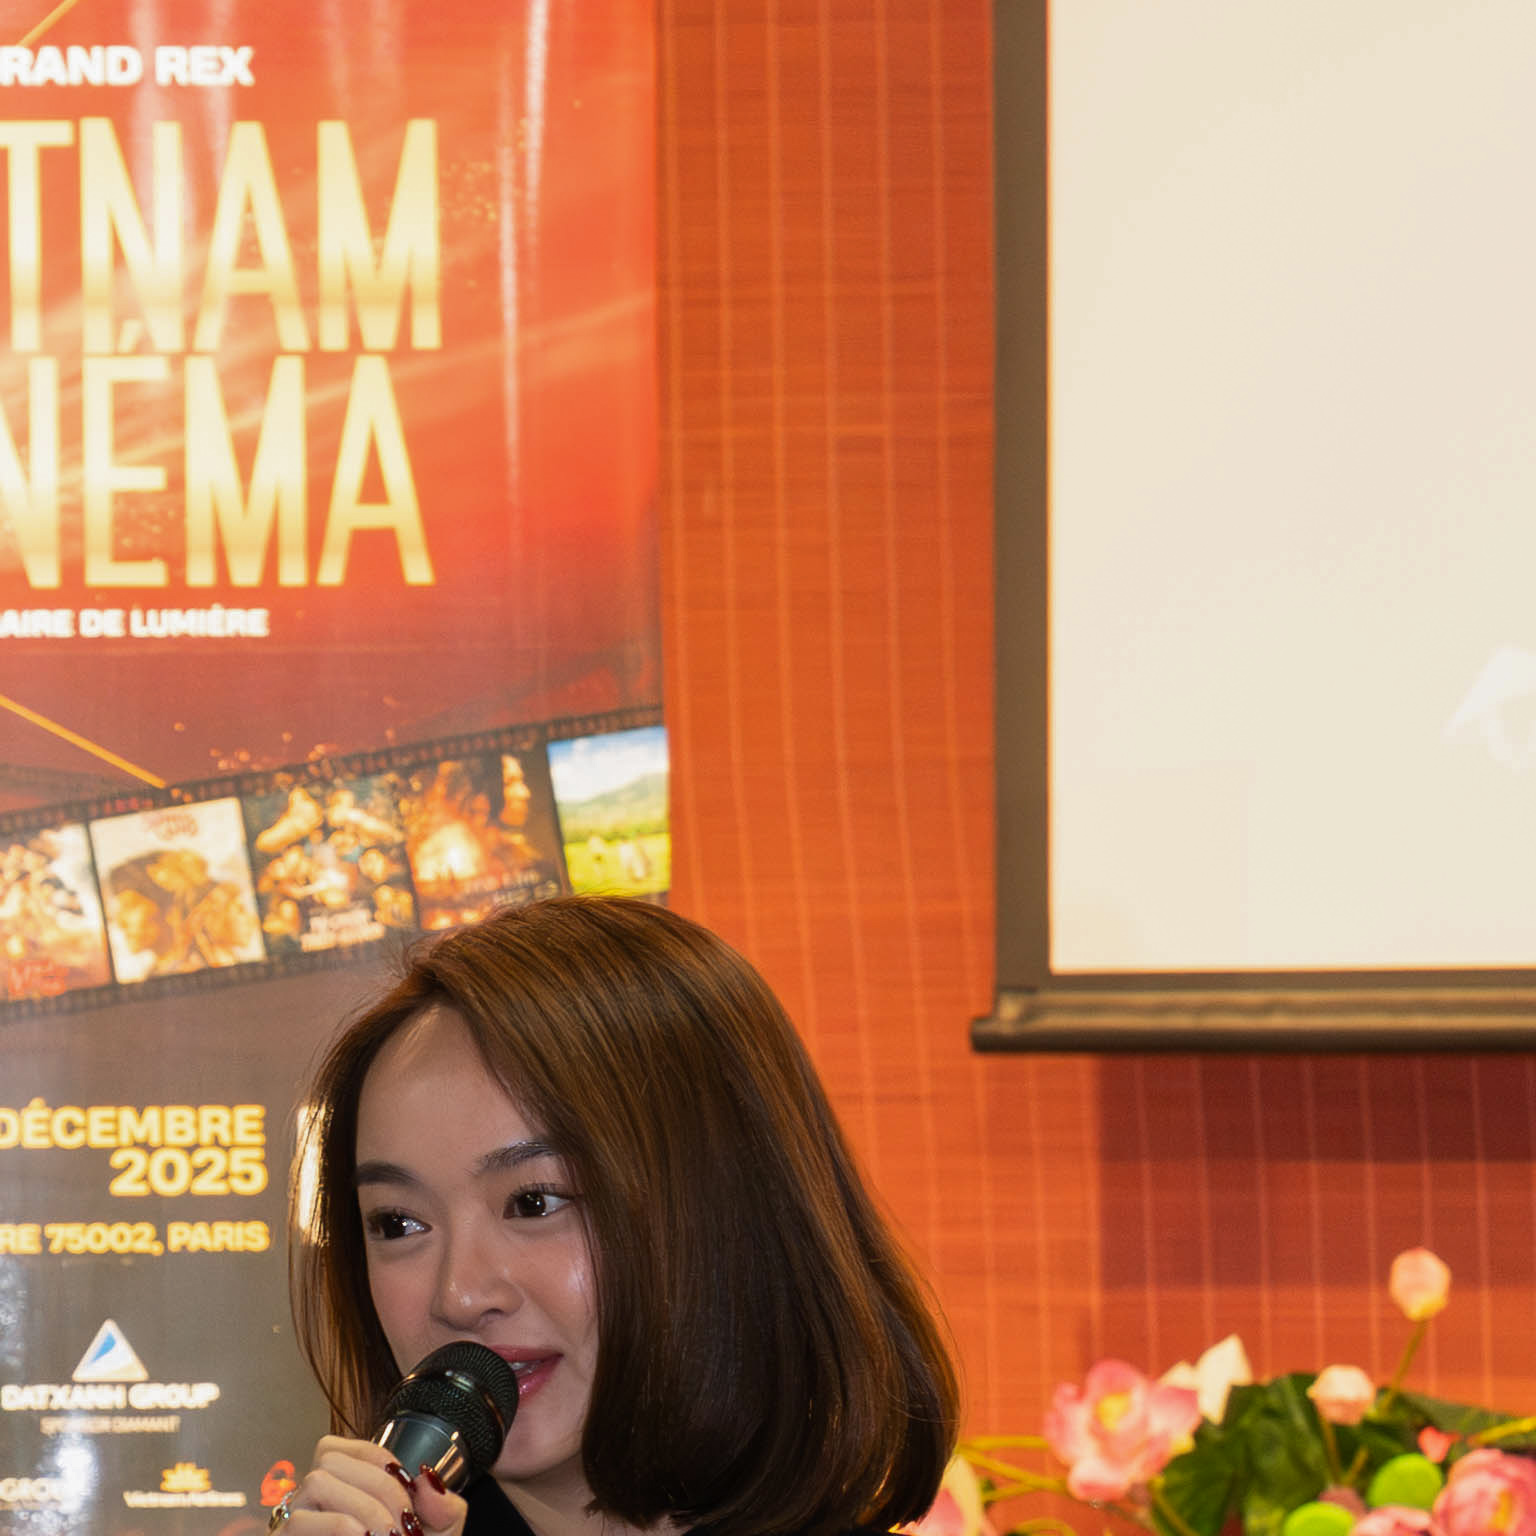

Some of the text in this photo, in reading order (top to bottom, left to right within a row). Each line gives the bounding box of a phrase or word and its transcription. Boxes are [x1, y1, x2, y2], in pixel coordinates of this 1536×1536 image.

[155, 45, 255, 87] REX
[79, 608, 127, 638] DE
[130, 603, 270, 638] LUMIÈRE
[109, 1146, 269, 1197] 2025
[44, 1222, 164, 1256] 75002,
[167, 1220, 270, 1253] PARIS
[128, 1382, 221, 1410] GROUP
